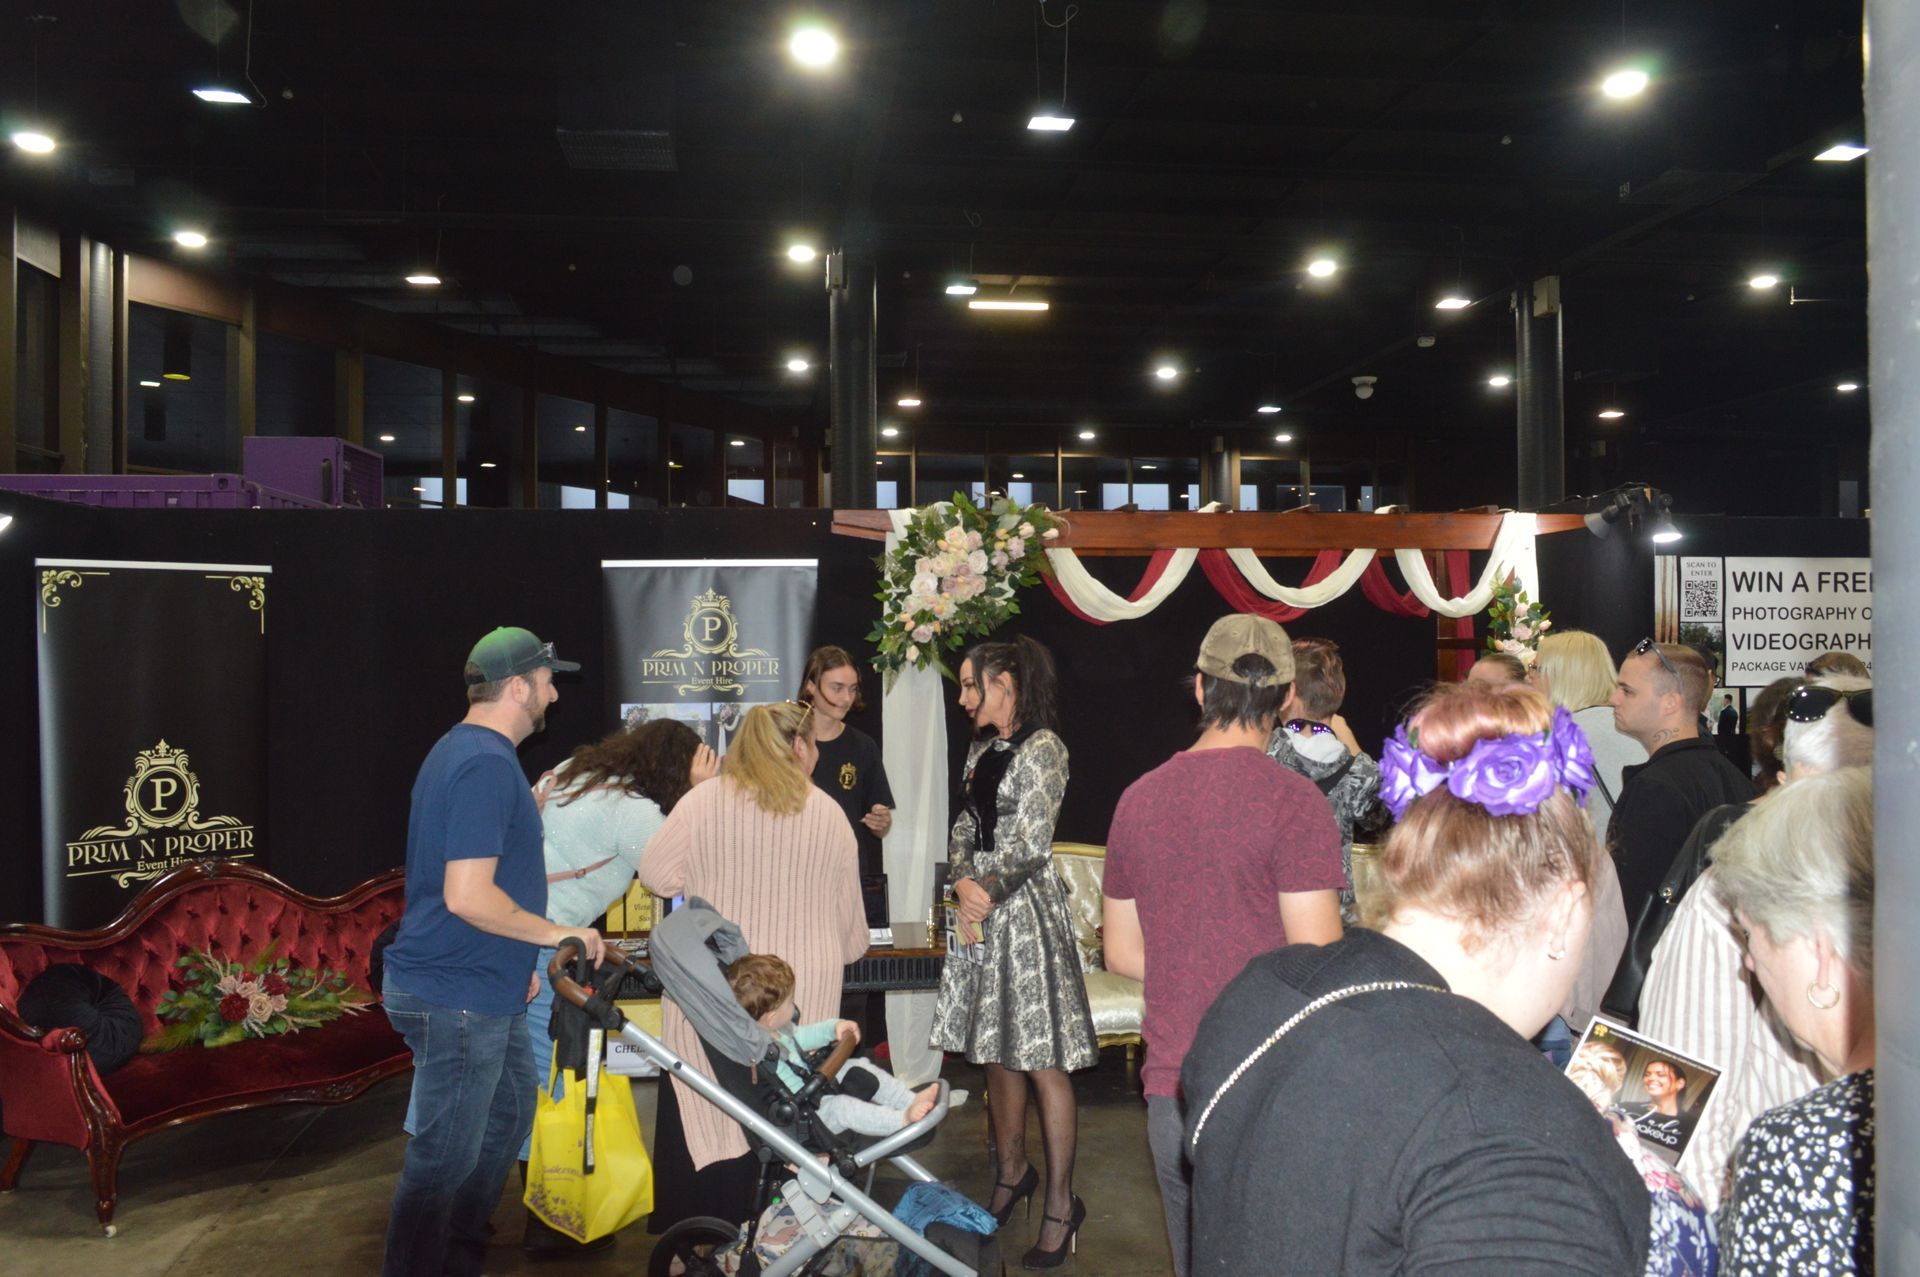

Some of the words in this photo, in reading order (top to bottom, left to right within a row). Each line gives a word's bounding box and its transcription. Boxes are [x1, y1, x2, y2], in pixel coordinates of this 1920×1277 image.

[1732, 571, 1783, 593] WIN
[1791, 571, 1810, 593] A
[1732, 606, 1857, 620] PHOTOGRAPHY
[701, 616, 721, 641] P
[643, 660, 687, 677] PRIM
[693, 660, 706, 676] N
[711, 660, 780, 676] PROPER
[1731, 661, 1786, 672] PACKAGE
[691, 676, 713, 685] Event
[715, 676, 734, 685] Hire
[150, 778, 178, 812] P
[67, 841, 131, 867] PRIM
[139, 838, 156, 859] N
[165, 829, 255, 857] PROPER
[137, 860, 168, 872] Event
